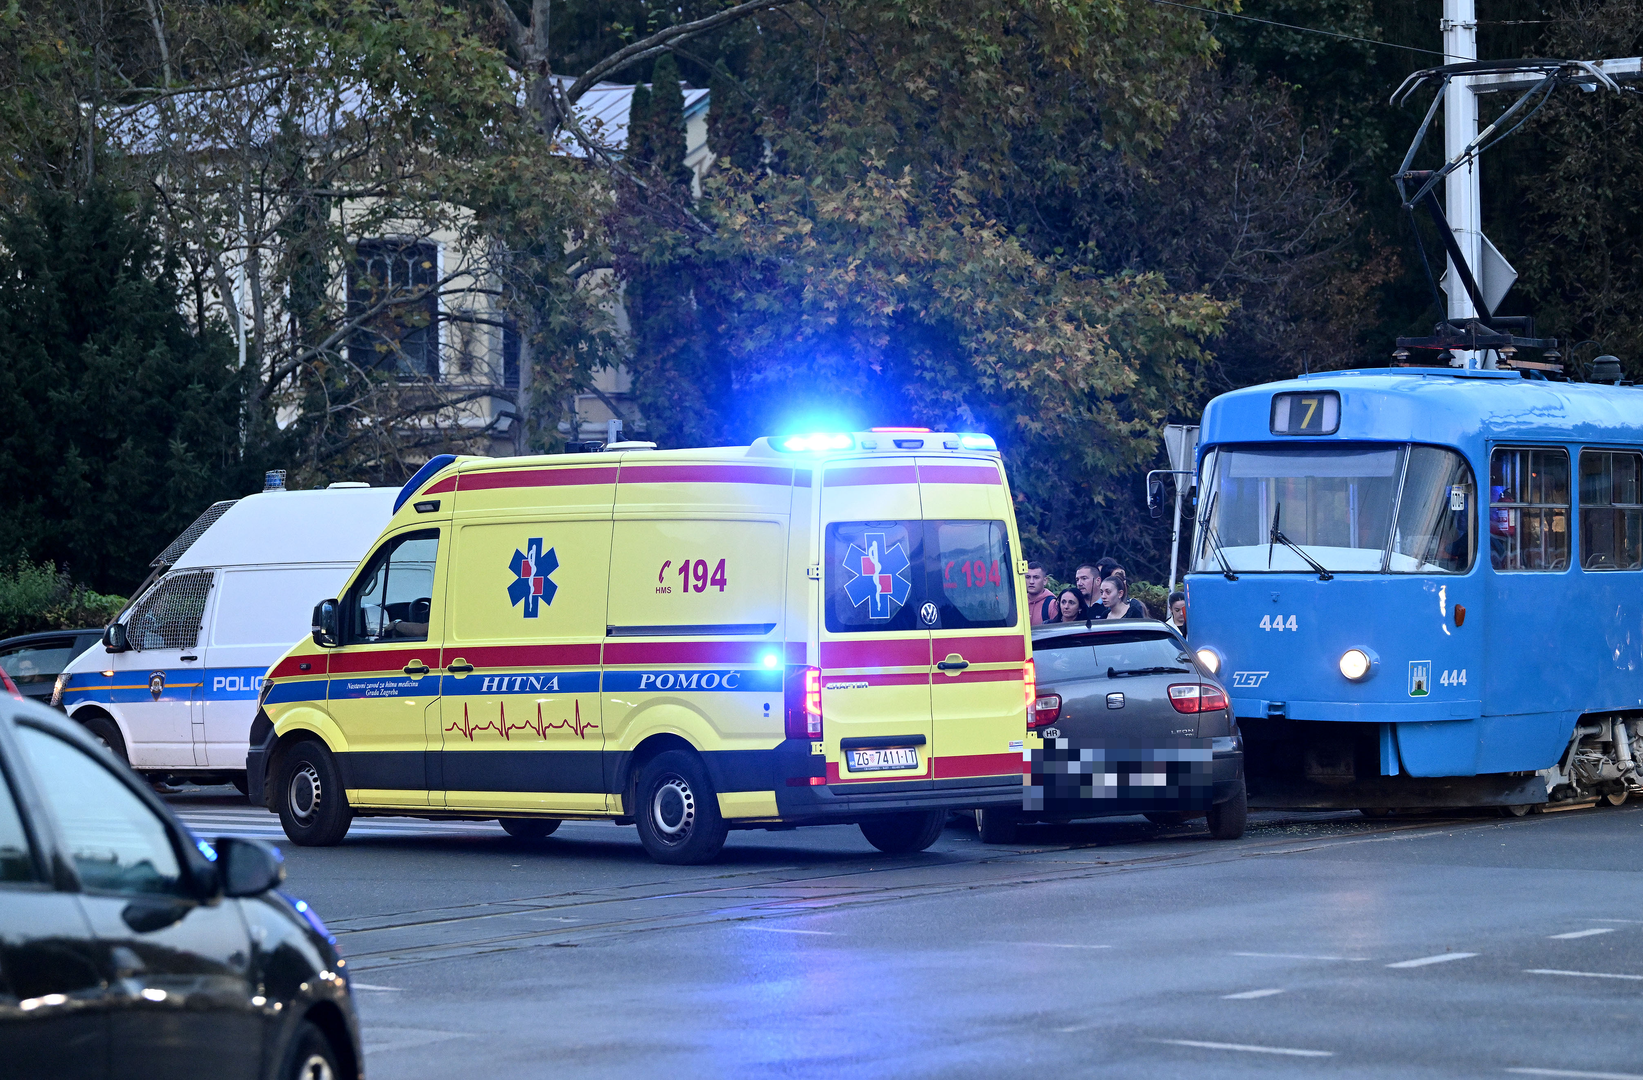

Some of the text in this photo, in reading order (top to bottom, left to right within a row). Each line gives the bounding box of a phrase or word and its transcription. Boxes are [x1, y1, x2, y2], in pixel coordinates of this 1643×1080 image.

[1301, 399, 1318, 429] 7
[678, 558, 727, 593] 194
[961, 559, 1001, 588] 194
[655, 586, 672, 594] HMS
[1259, 614, 1298, 632] 444
[480, 670, 741, 692] HITNA POMOĆ
[1233, 671, 1270, 688] ZET
[1440, 669, 1468, 687] 444
[379, 688, 399, 697] Zagreba
[855, 750, 915, 766] ZG 7411-IT
